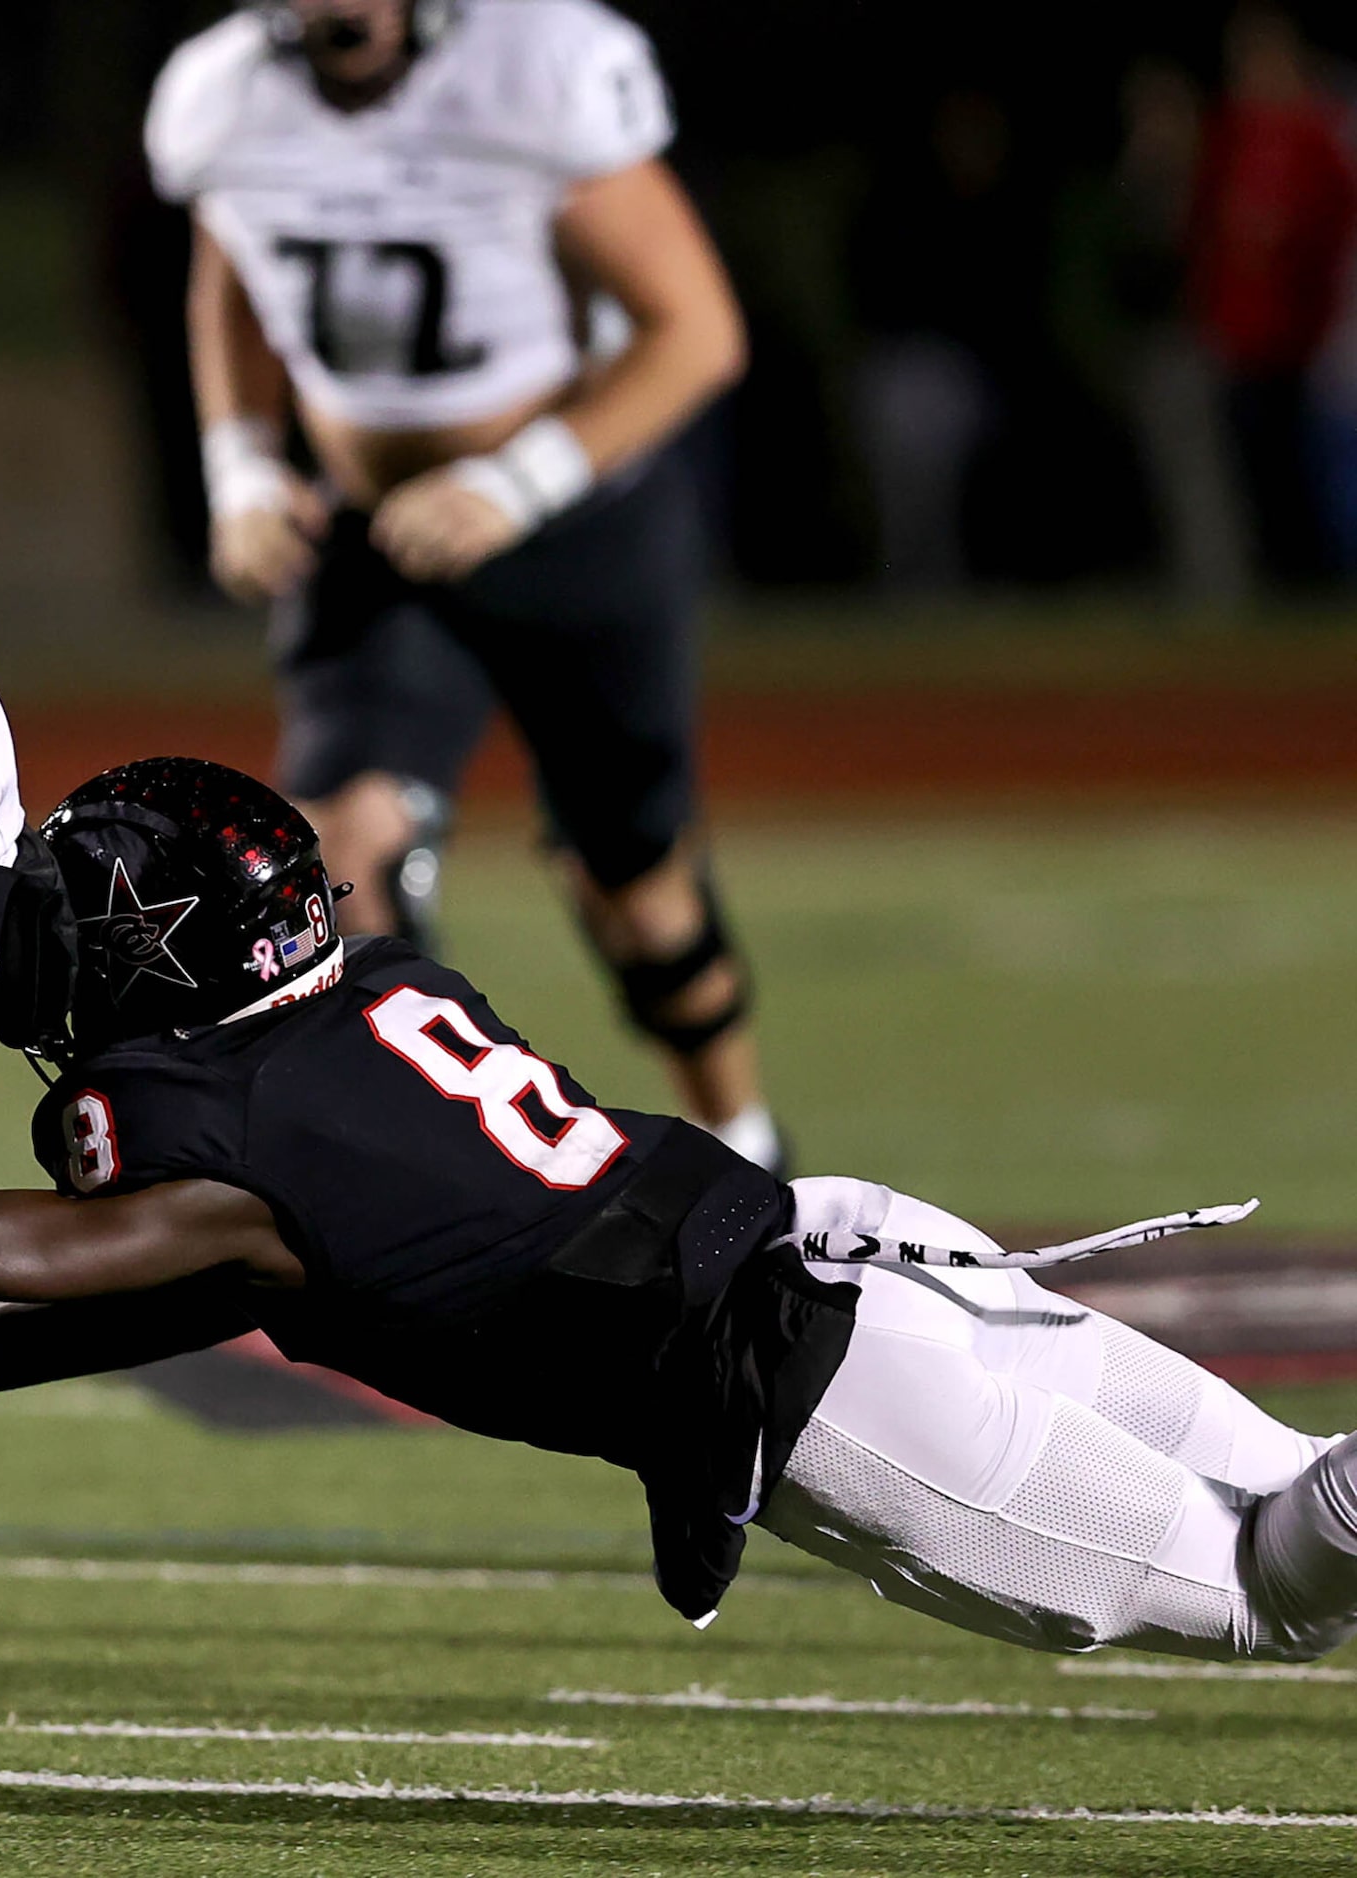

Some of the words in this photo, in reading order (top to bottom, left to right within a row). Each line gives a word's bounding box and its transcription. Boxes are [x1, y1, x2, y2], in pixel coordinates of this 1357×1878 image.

[305, 893, 329, 947] 8
[62, 1087, 122, 1194] 8
[361, 983, 632, 1191] 8
